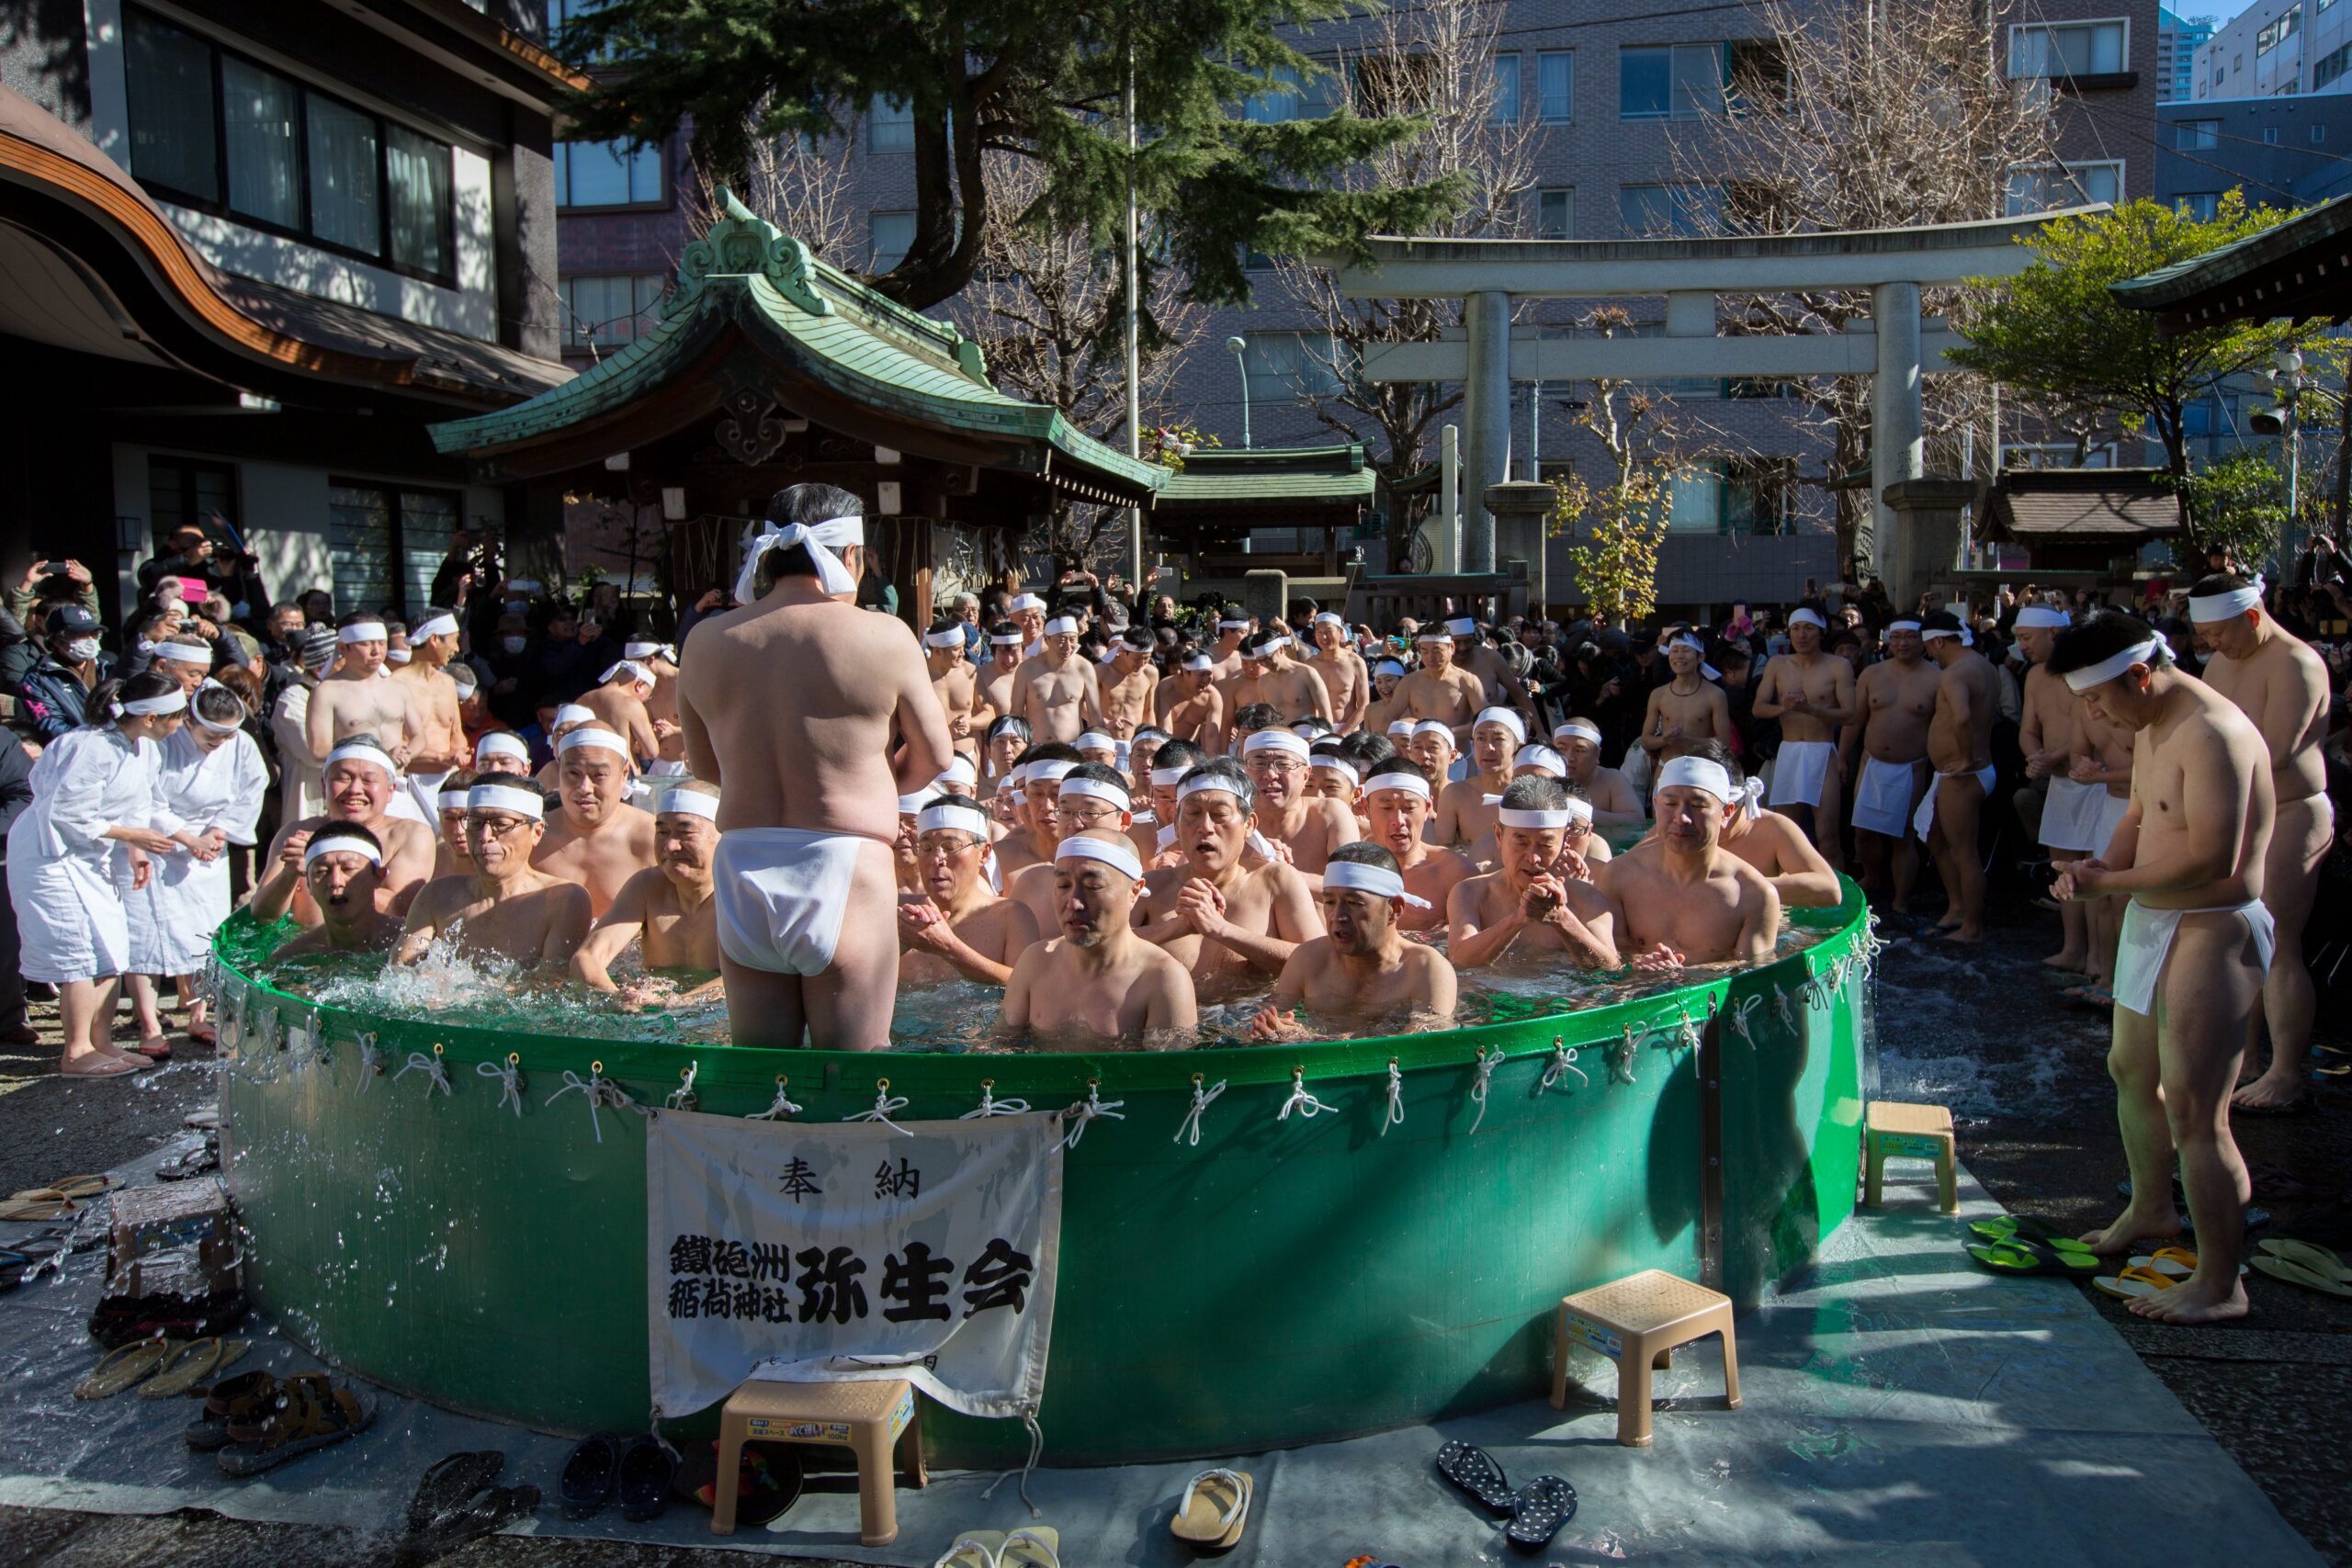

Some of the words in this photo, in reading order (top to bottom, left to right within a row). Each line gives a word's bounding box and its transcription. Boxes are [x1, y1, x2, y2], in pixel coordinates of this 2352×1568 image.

[779, 1156, 920, 1203] 奉納
[668, 1278, 792, 1324] 稲荷神社
[795, 1238, 1034, 1325] 弥生会
